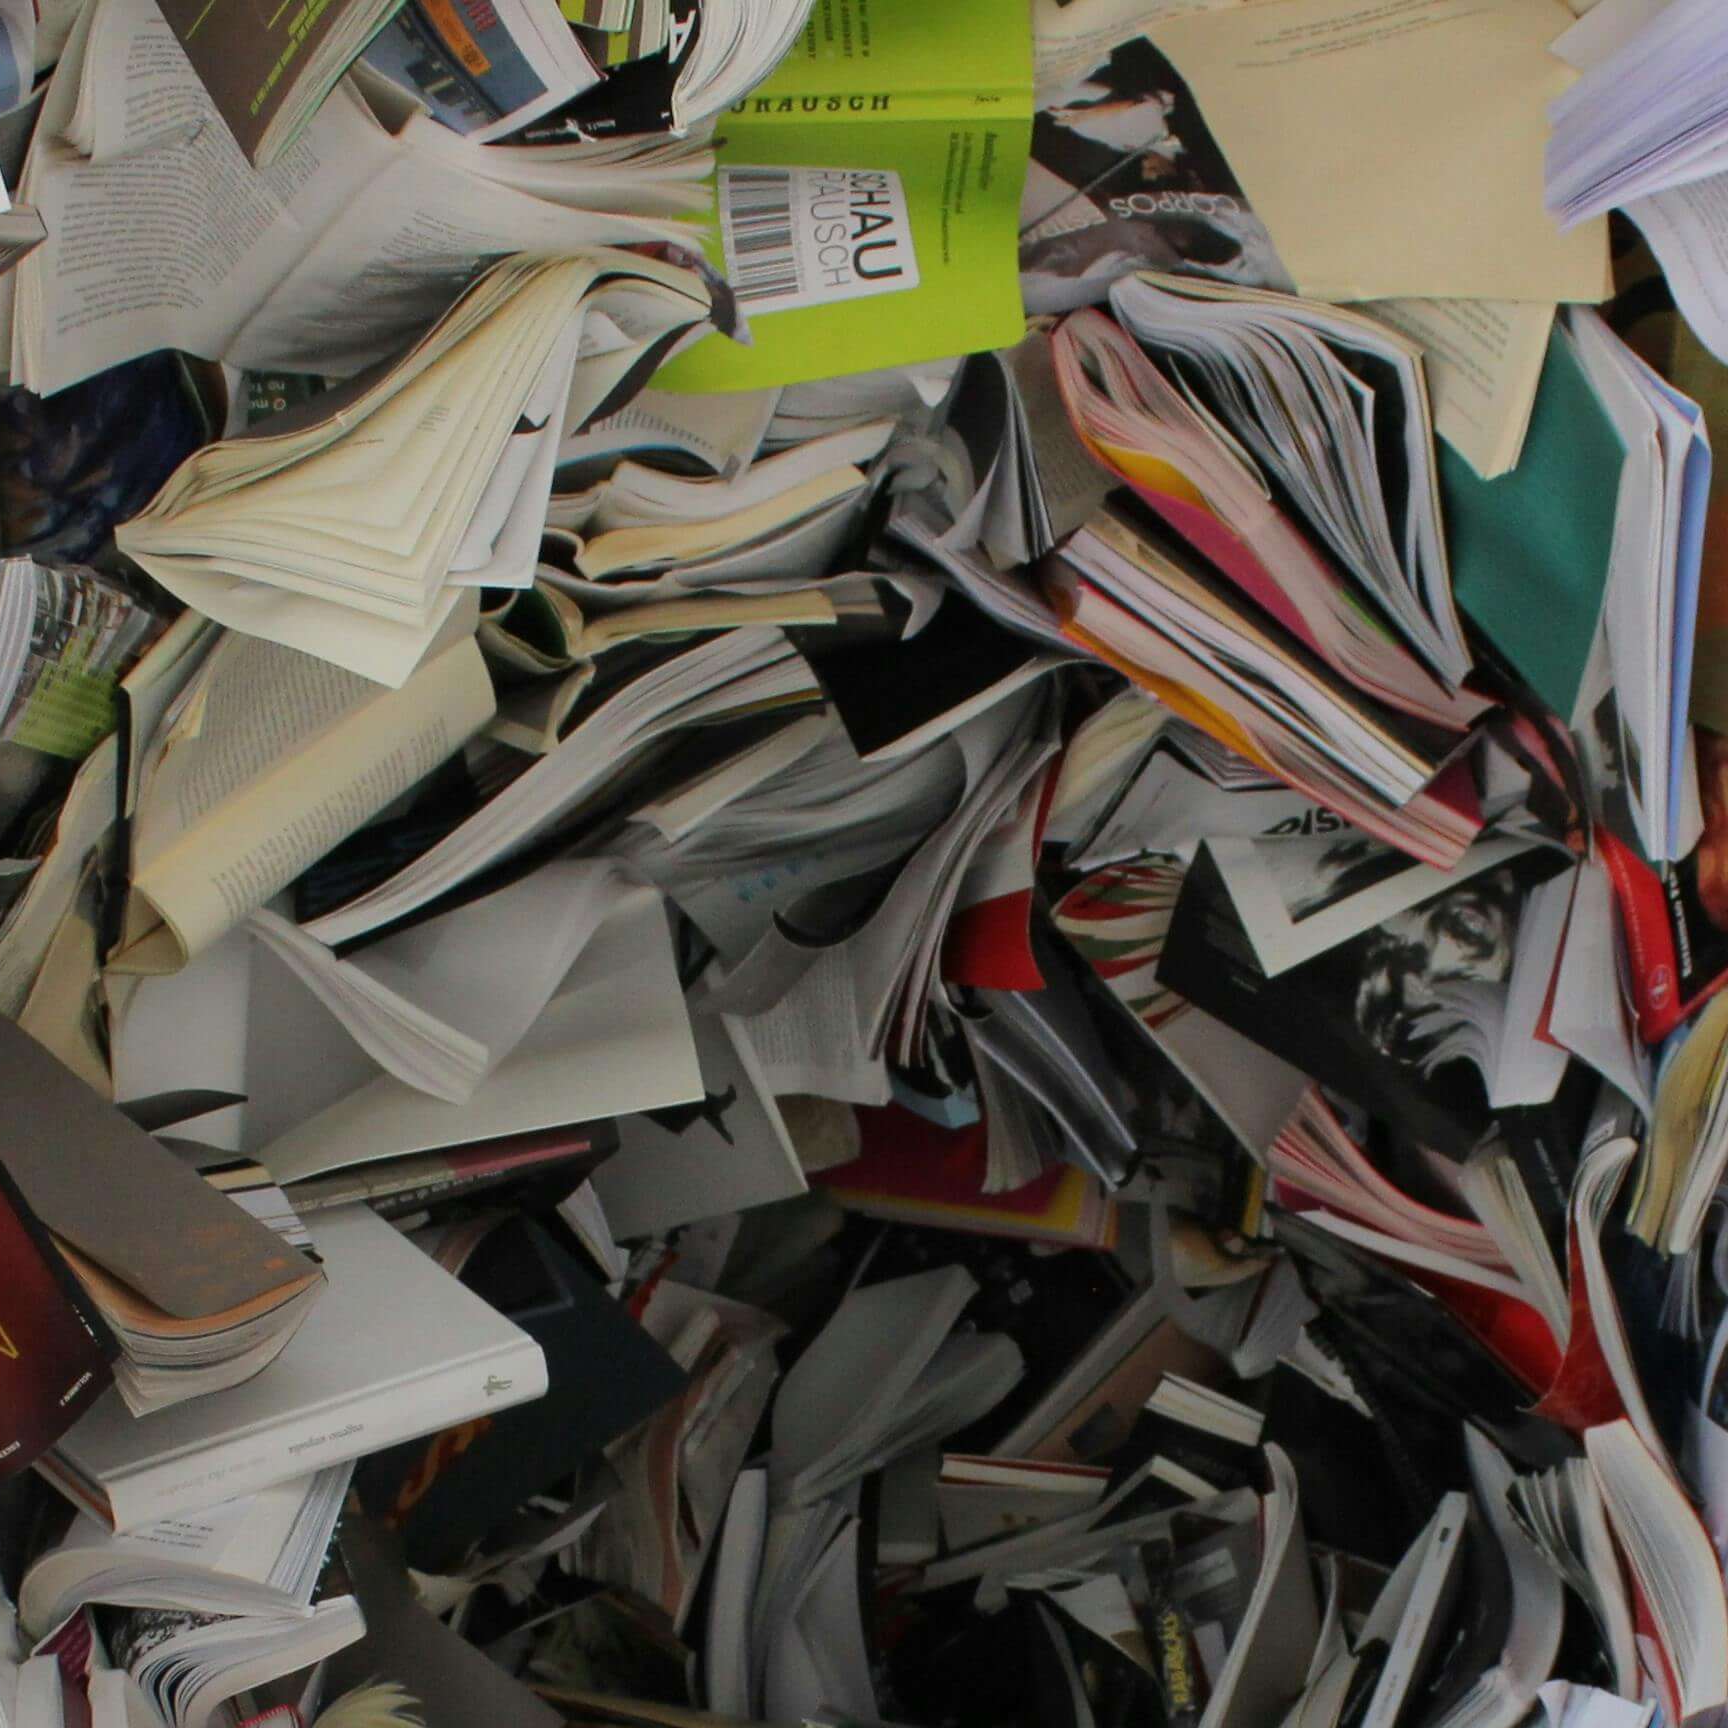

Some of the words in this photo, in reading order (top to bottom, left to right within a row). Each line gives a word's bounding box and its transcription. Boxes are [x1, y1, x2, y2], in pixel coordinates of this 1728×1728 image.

[808, 171, 852, 288] RAUSCH
[850, 171, 903, 281] SCHAU
[1108, 191, 1240, 219] CORPOS
